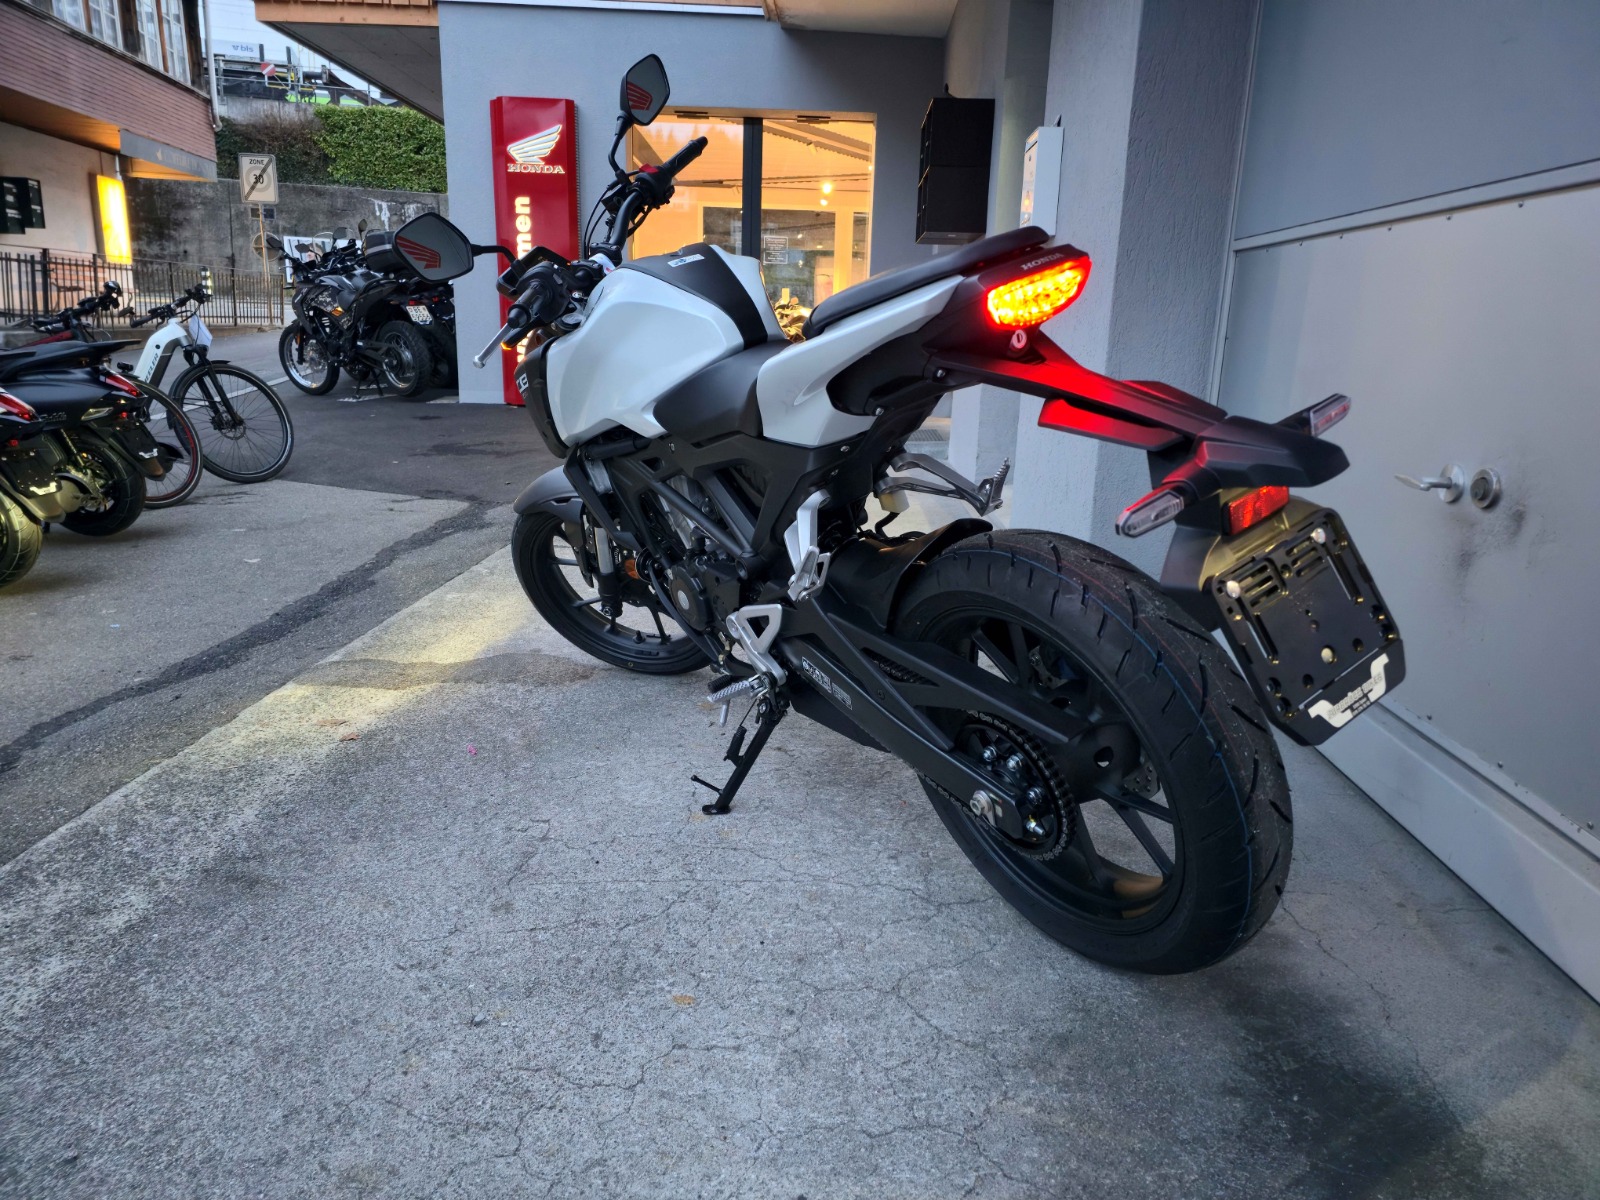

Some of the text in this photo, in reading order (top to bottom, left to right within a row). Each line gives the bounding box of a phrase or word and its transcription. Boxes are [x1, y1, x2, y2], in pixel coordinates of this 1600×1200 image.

[241, 44, 254, 53] bls
[249, 158, 265, 166] ZONE
[507, 163, 565, 174] HONDA
[253, 174, 264, 185] 30
[1020, 252, 1064, 271] HONDA
